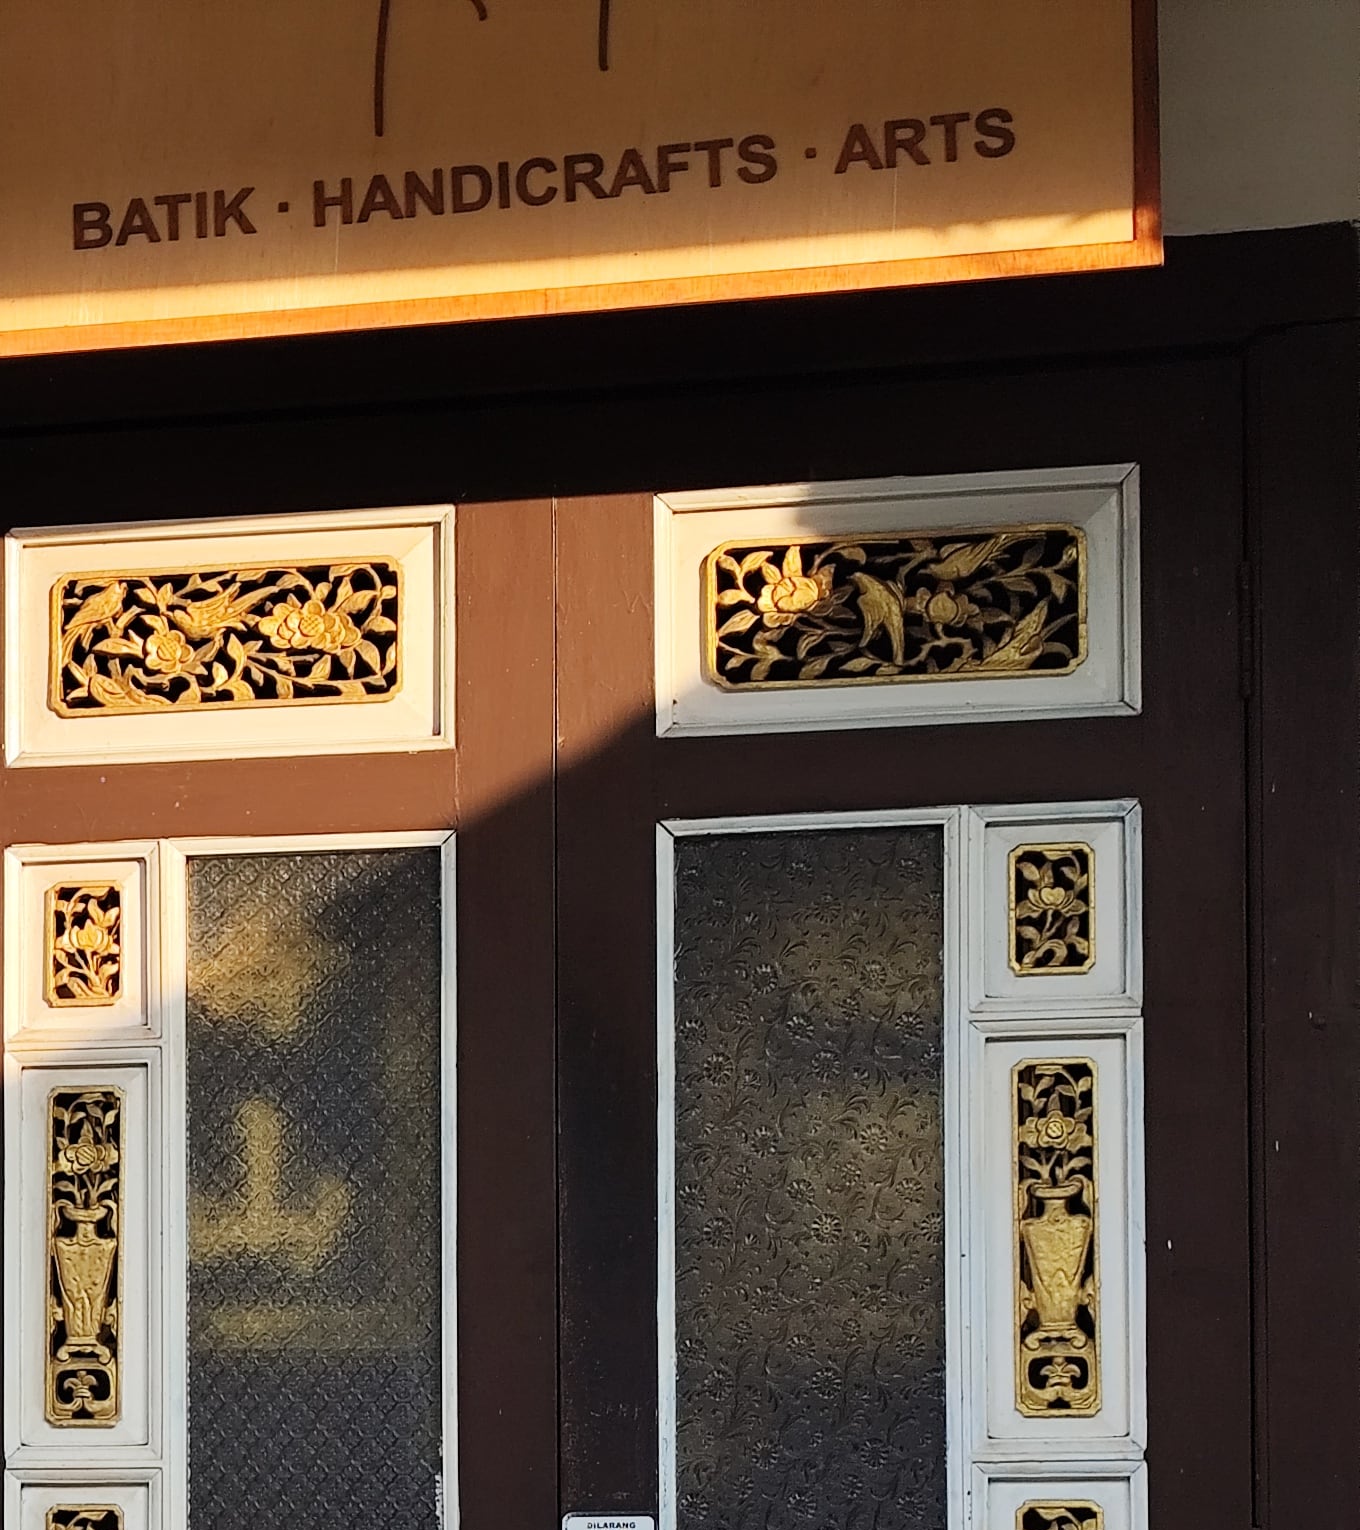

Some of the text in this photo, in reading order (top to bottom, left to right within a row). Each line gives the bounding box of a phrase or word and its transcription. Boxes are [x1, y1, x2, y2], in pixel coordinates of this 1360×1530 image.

[73, 107, 1016, 250] BATIK HANDICRAFTS ARTS
